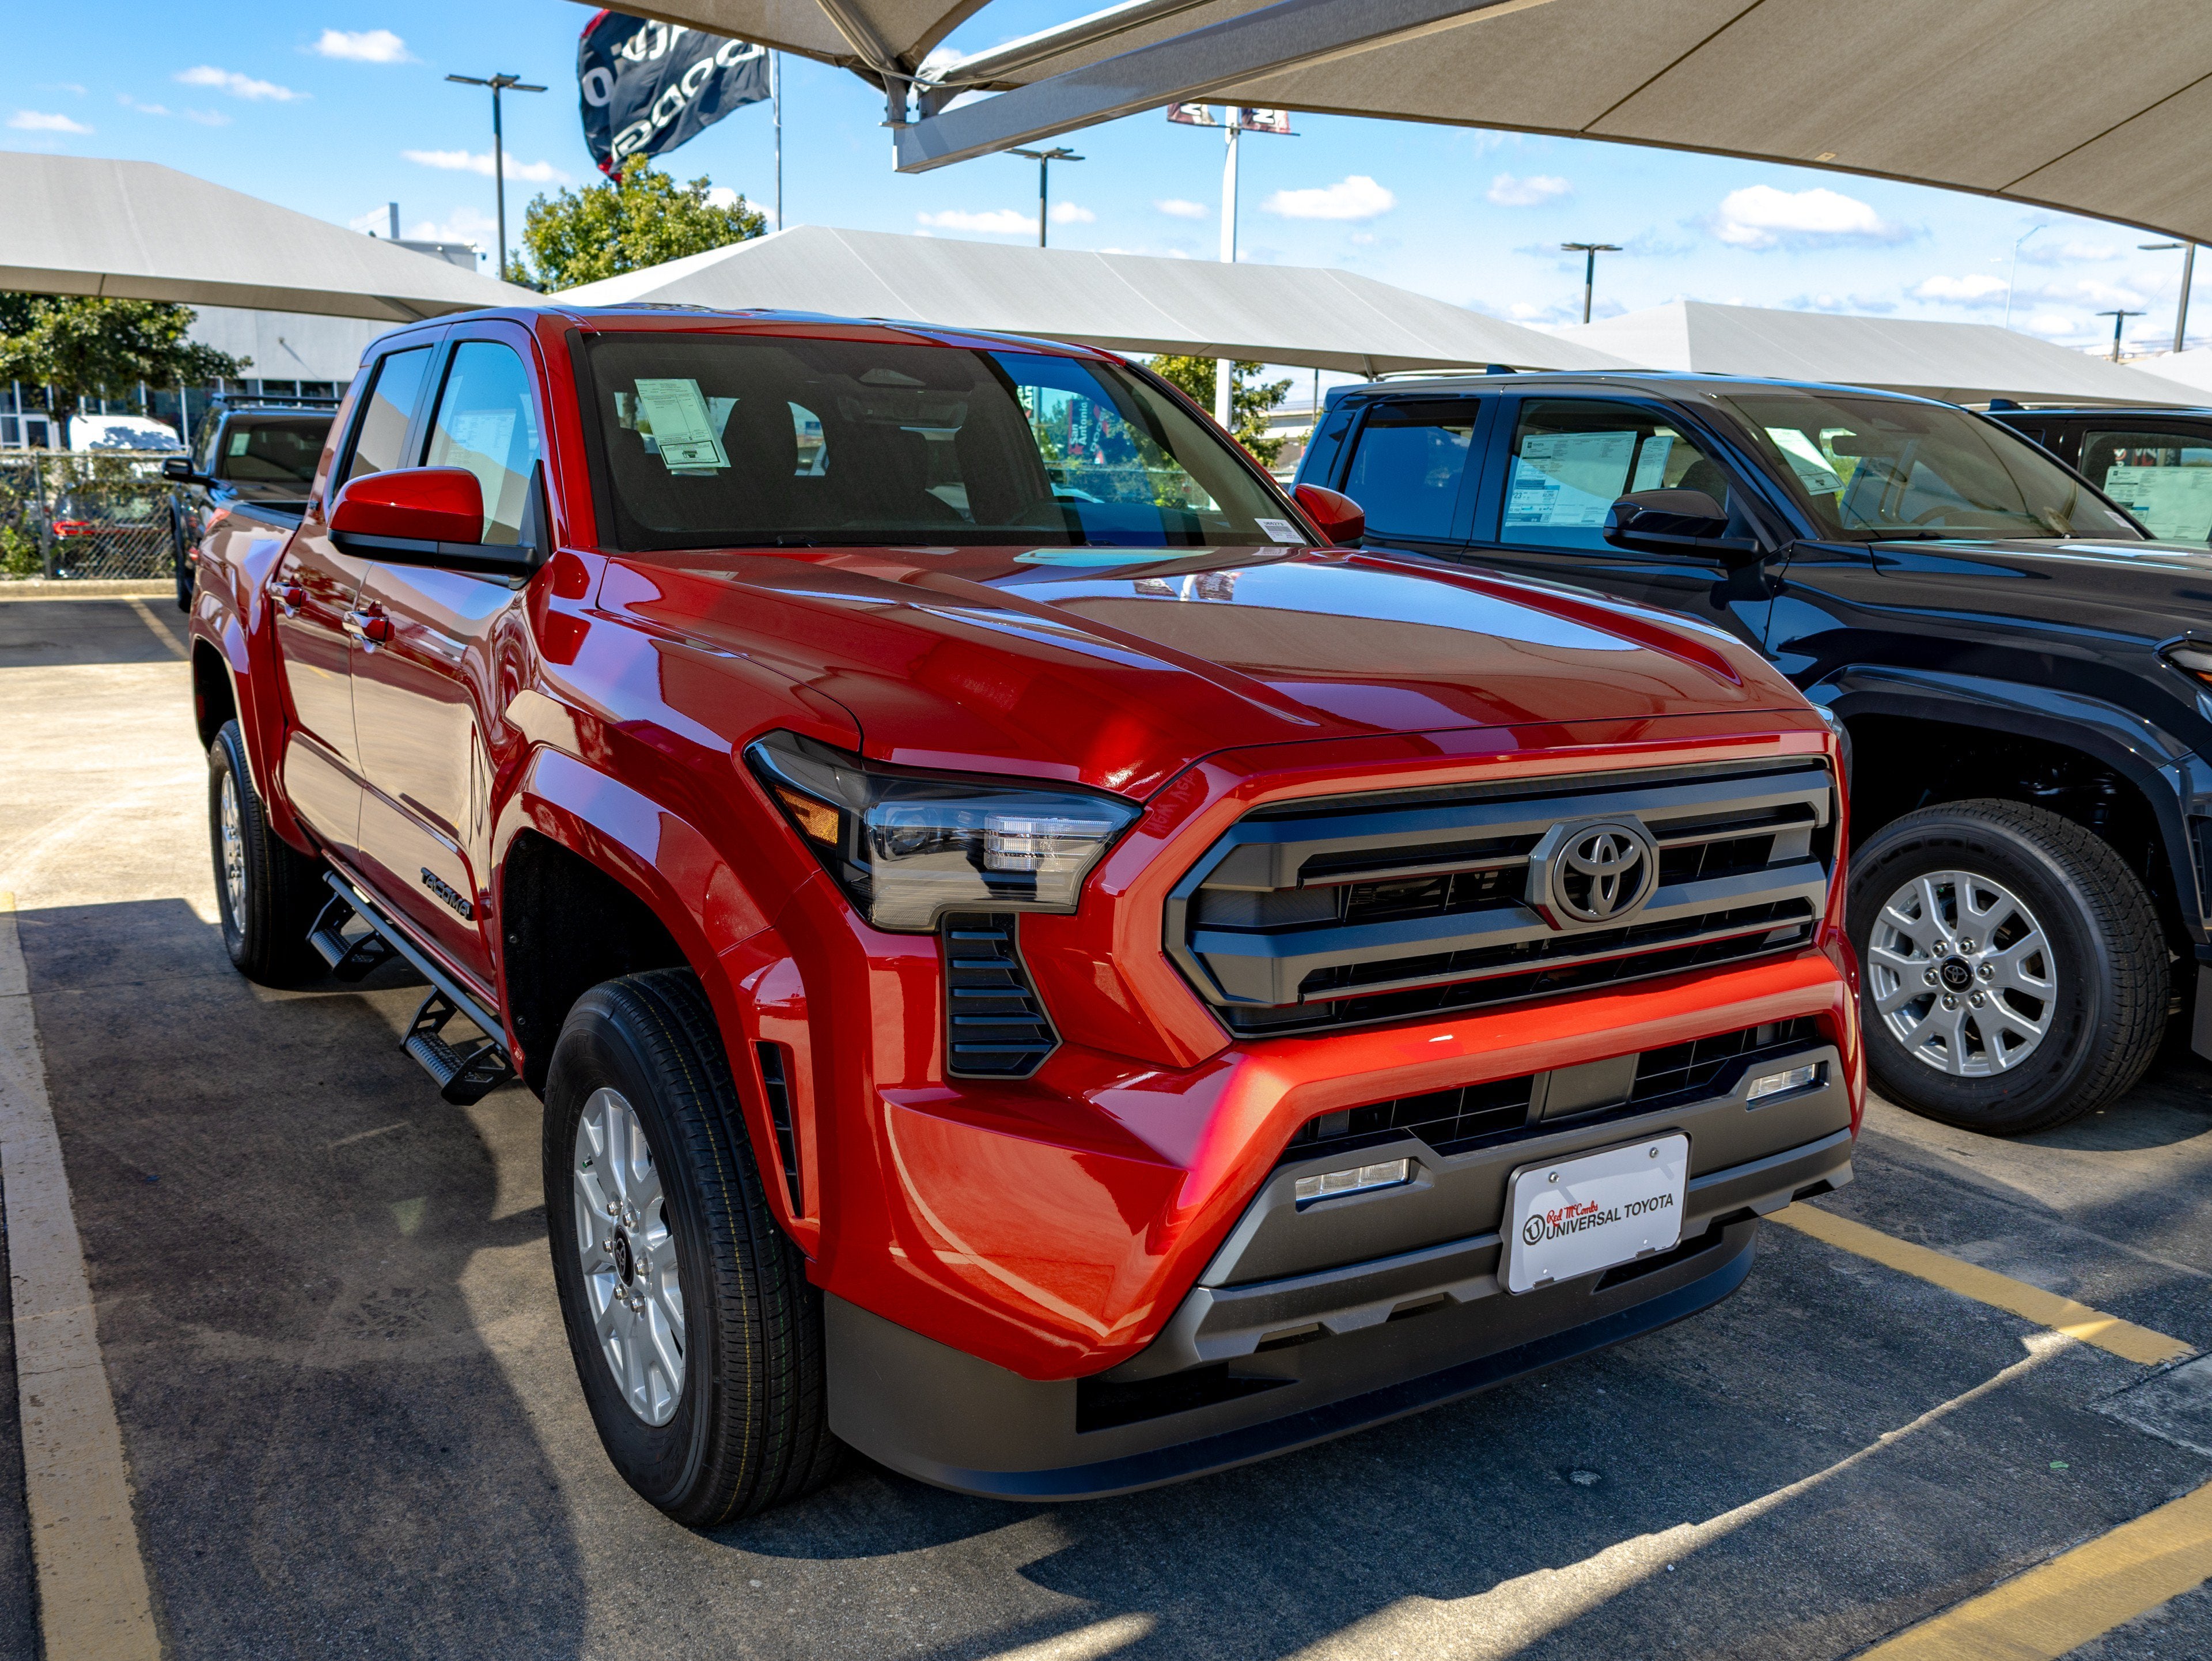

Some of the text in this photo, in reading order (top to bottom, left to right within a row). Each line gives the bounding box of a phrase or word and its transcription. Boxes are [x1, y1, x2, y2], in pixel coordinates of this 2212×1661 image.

[1070, 423, 1079, 445] San
[1078, 402, 1088, 445] Antonio
[421, 867, 472, 920] TACOMA
[1546, 1207, 1622, 1240] UNIVERSAL
[1624, 1193, 1673, 1218] TOYOTA
[1547, 1200, 1598, 1227] Red McCombs
